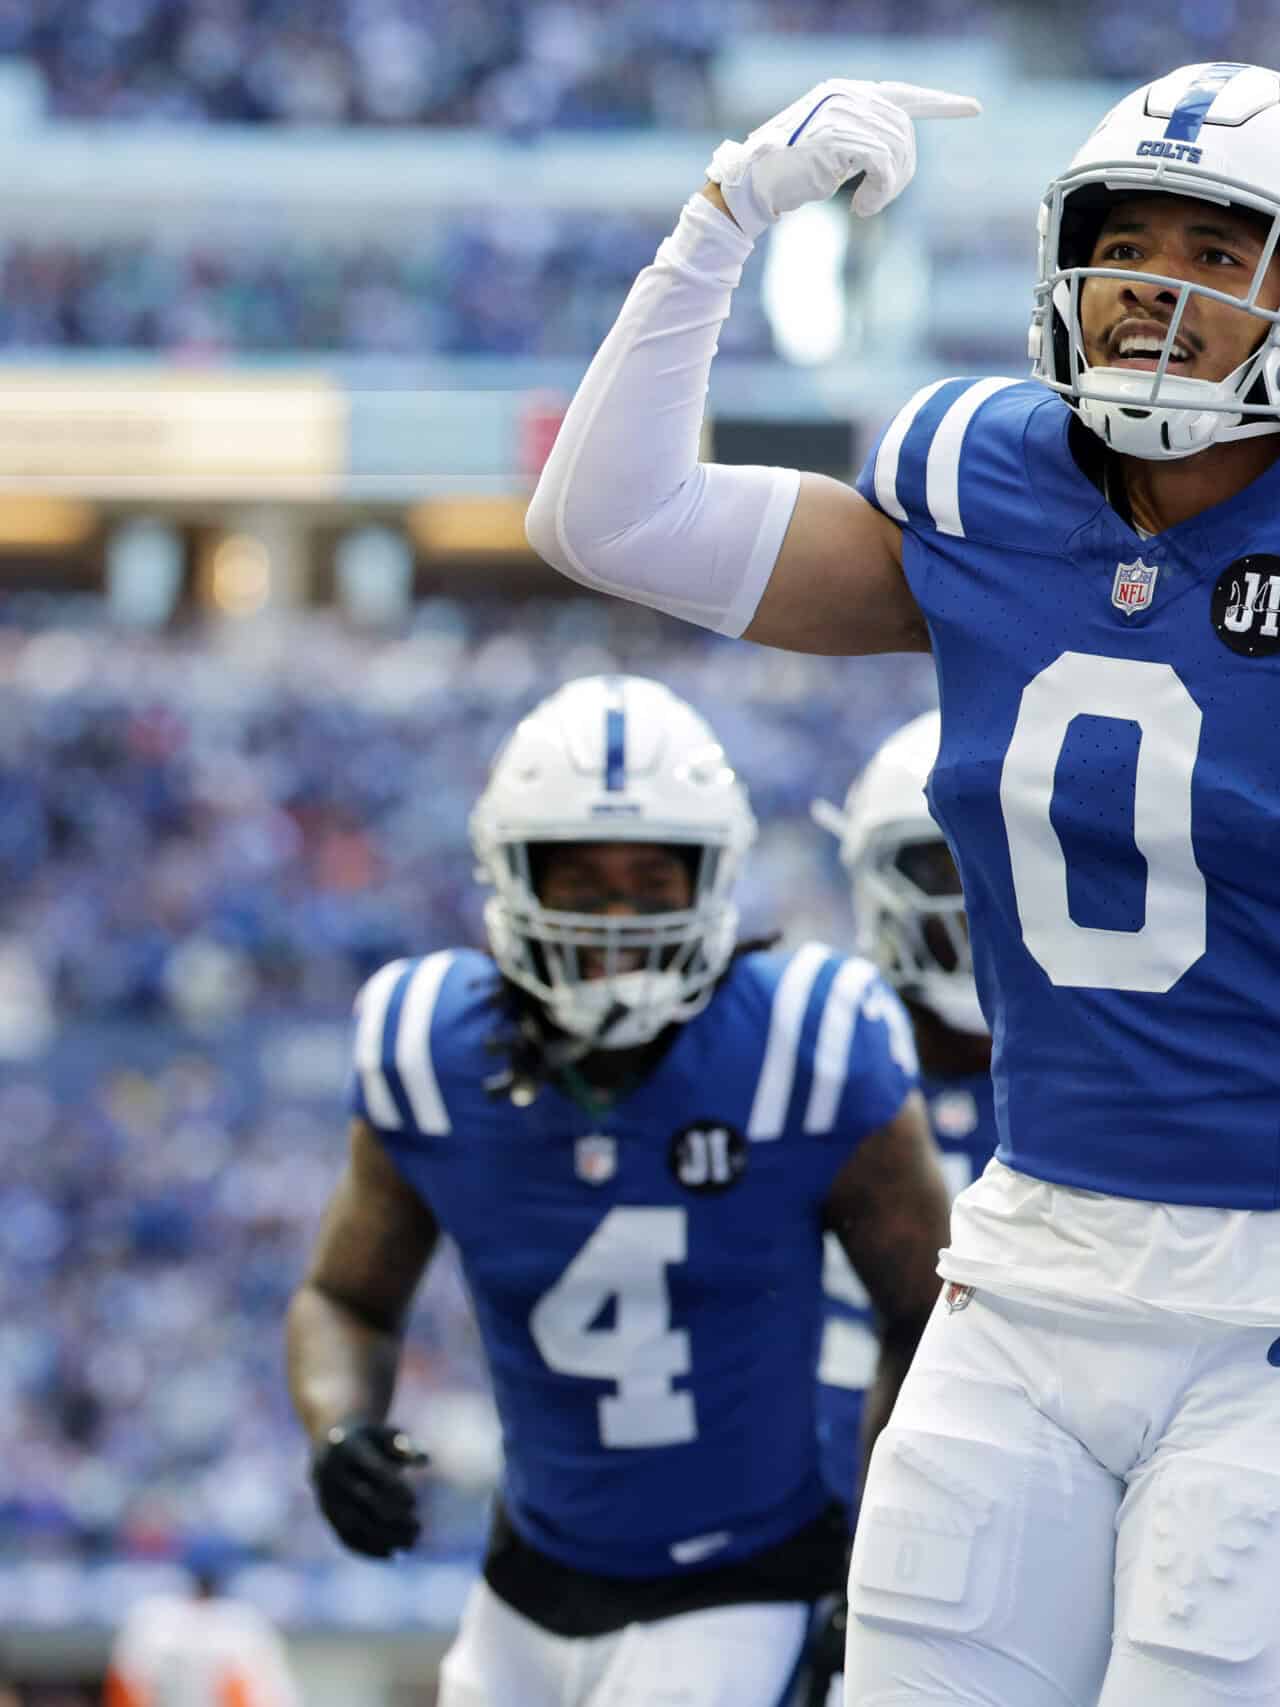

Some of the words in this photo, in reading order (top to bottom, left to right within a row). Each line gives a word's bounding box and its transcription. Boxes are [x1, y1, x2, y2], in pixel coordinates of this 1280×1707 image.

[1136, 140, 1203, 164] COLTS
[1119, 582, 1146, 604] NFL
[999, 651, 1207, 993] 0
[530, 1205, 698, 1450] 4
